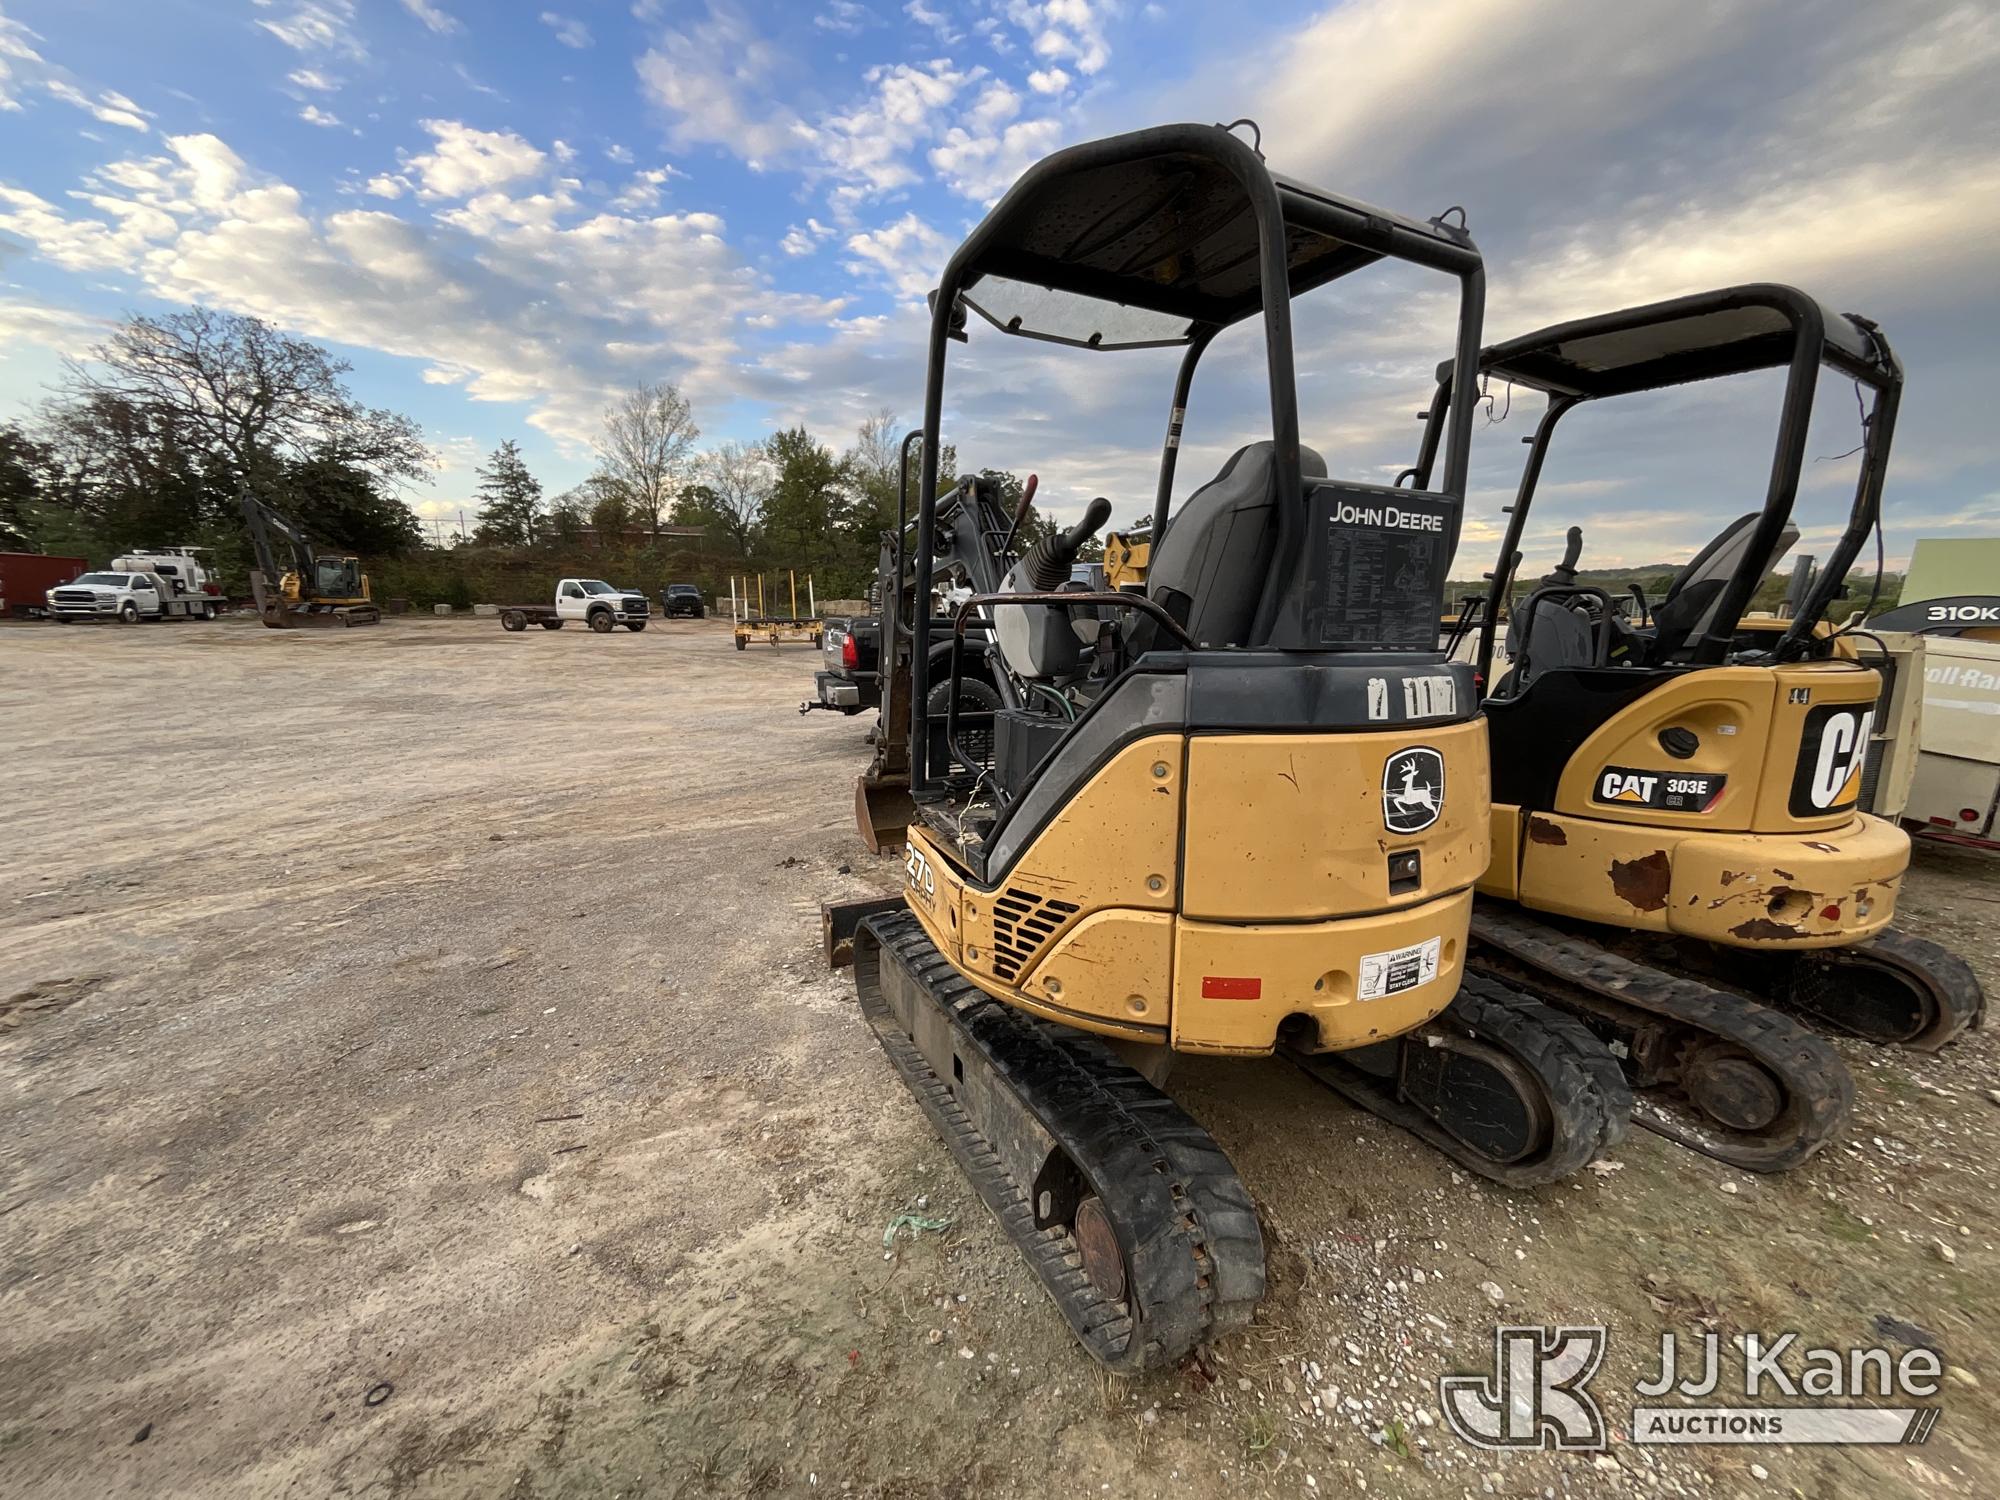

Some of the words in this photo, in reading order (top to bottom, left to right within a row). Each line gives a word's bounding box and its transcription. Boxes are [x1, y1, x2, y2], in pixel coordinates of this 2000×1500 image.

[1329, 501, 1382, 526] JOHN
[1385, 506, 1443, 532] DEERE
[1927, 606, 2000, 620] 310K
[1924, 666, 2000, 691] oll-Ra
[1790, 688, 1810, 705] 44
[1811, 709, 1876, 809] CA
[1602, 773, 1658, 803] CAT
[1667, 779, 1708, 795] 303E
[902, 841, 935, 895] 27D
[1395, 948, 1421, 960] WARNING
[1402, 977, 1416, 986] CLEAR
